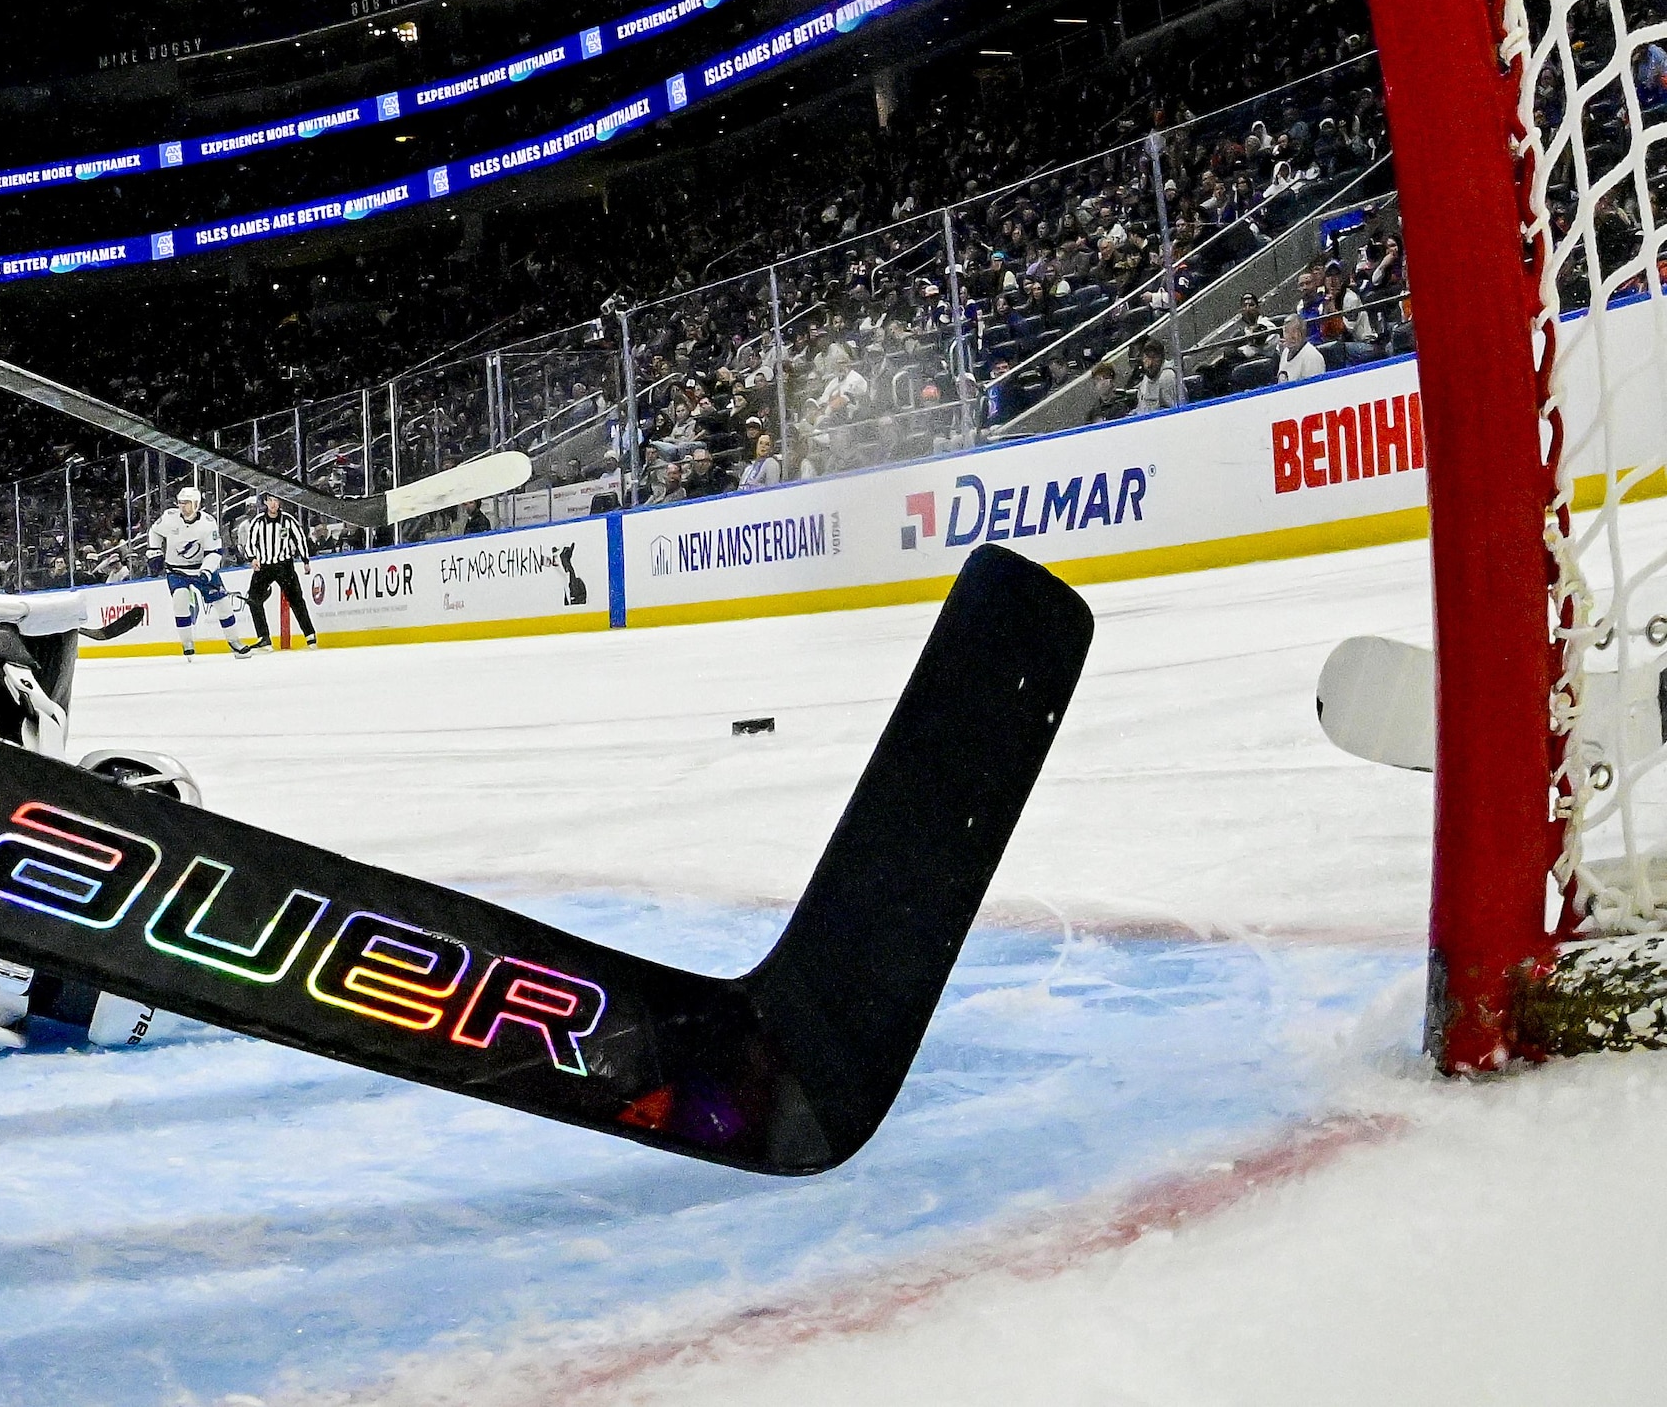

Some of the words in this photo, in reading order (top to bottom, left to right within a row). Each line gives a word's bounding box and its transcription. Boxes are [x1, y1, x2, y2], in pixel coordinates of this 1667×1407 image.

[2, 256, 49, 276] BETTER
[50, 245, 127, 270] #WITHAMEX
[945, 464, 1148, 548] DELMAR
[678, 532, 713, 573] NEW
[715, 514, 826, 569] AMSTERDAM
[830, 511, 841, 555] VODKA
[335, 563, 414, 602] TAYLOR
[441, 555, 462, 584] EAT
[468, 551, 495, 582] MOR
[499, 544, 544, 578] CHIKIN
